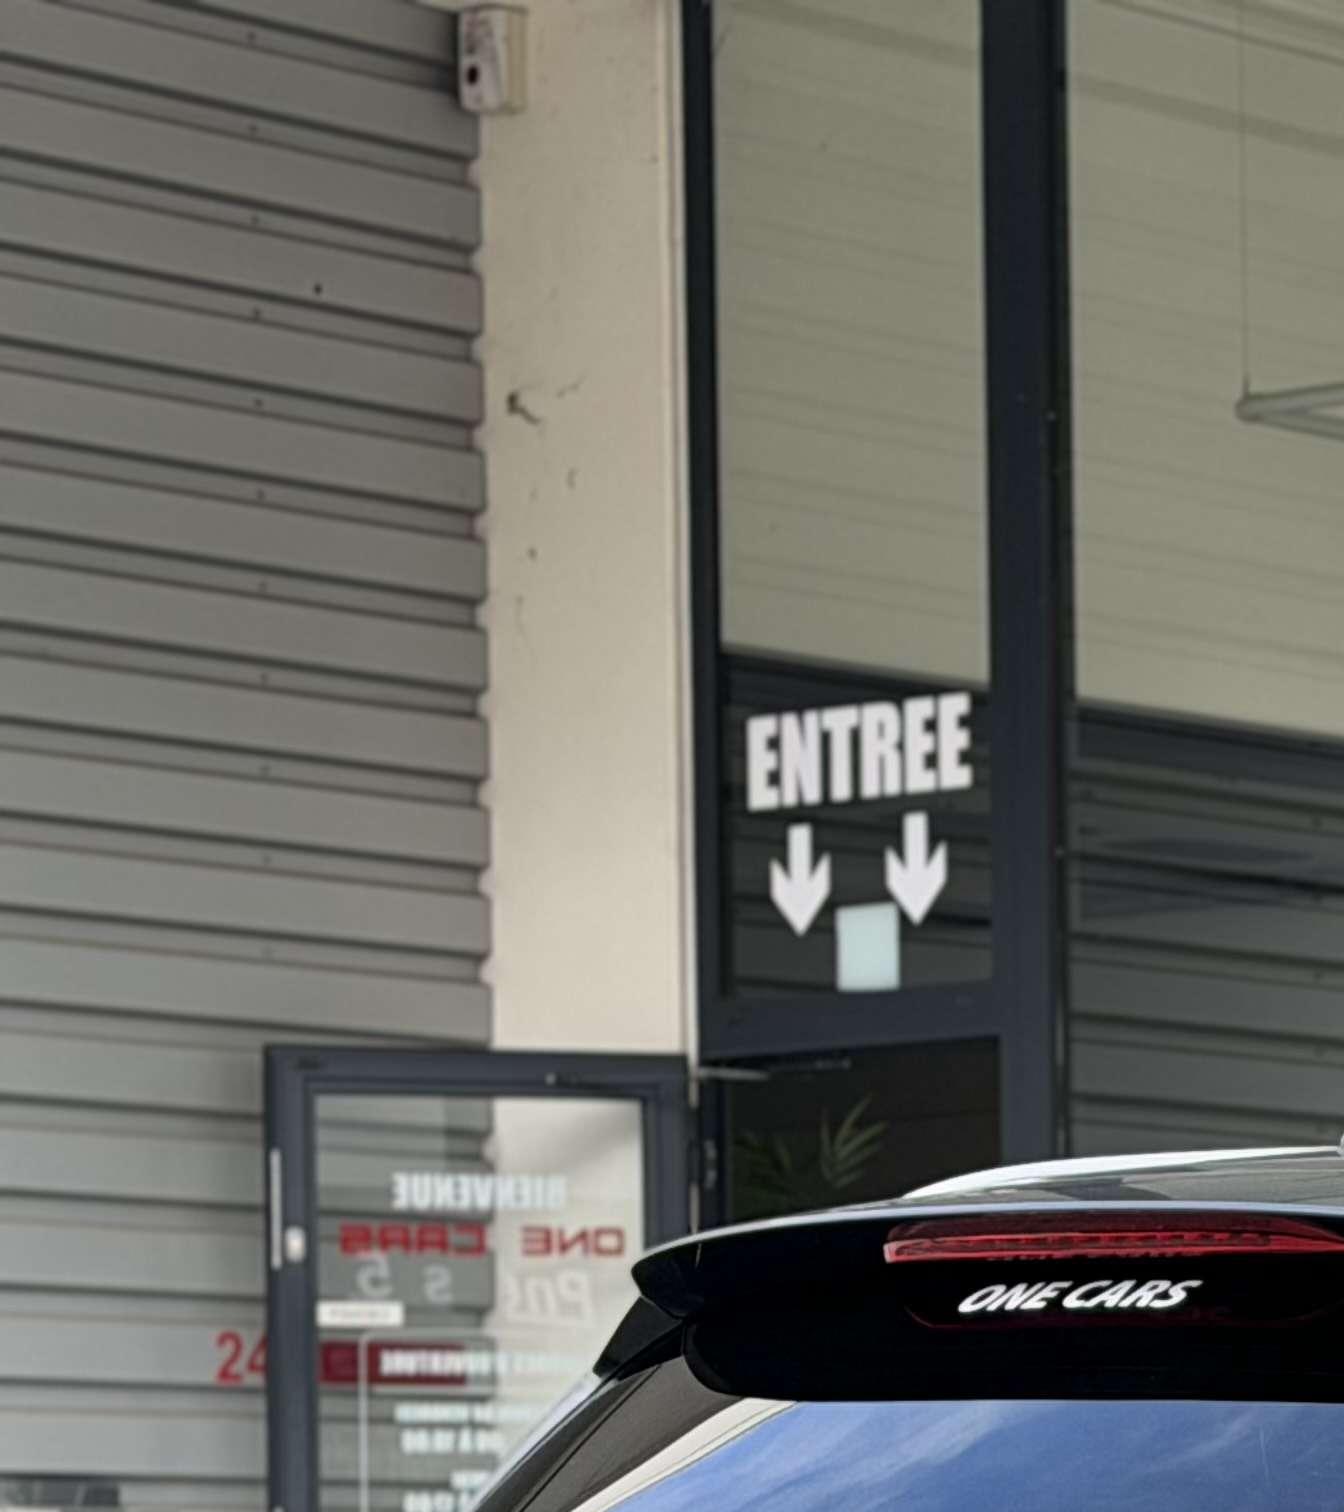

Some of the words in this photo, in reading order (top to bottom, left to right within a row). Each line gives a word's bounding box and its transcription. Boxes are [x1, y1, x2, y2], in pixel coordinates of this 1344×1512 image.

[746, 690, 973, 813] ENTREE
[958, 1281, 1073, 1313] ONE
[1061, 1279, 1203, 1308] CARS
